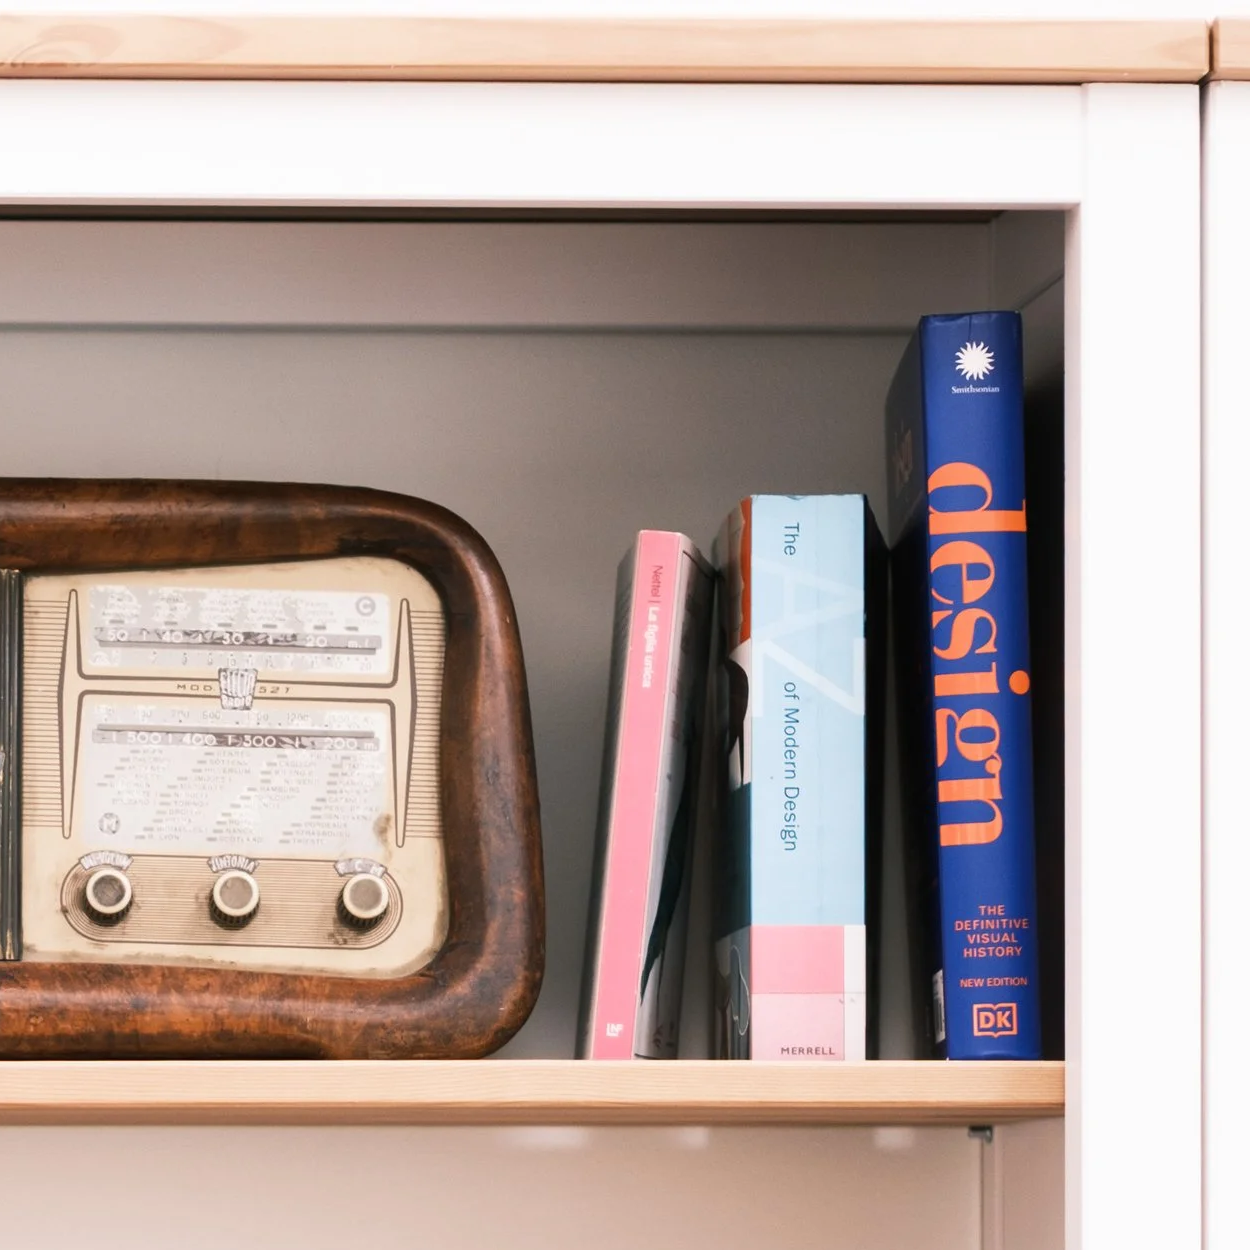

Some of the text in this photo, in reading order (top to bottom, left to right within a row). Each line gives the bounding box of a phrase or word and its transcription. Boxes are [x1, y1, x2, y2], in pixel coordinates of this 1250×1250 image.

[951, 385, 1000, 394] Smithsonian
[650, 565, 663, 598] Nettel
[647, 606, 660, 621] La
[107, 632, 129, 642] 50
[161, 632, 184, 643] 40
[222, 633, 245, 645] 30
[305, 636, 328, 647] 20
[927, 462, 1031, 847] design
[642, 655, 657, 689] unica
[258, 686, 291, 694] 521
[780, 522, 800, 852] The of Modern Design
[127, 732, 162, 743] 500
[182, 733, 218, 745] 400
[242, 735, 277, 747] 300
[325, 738, 358, 749] 200
[978, 904, 1006, 916] THE
[954, 918, 1030, 931] DEFINITIVE
[967, 932, 1018, 944] VISUAL
[963, 946, 1022, 958] HISTORY
[959, 977, 1028, 988] NEW EDITION
[979, 1010, 1012, 1029] DK
[780, 1046, 836, 1056] MERRELL
